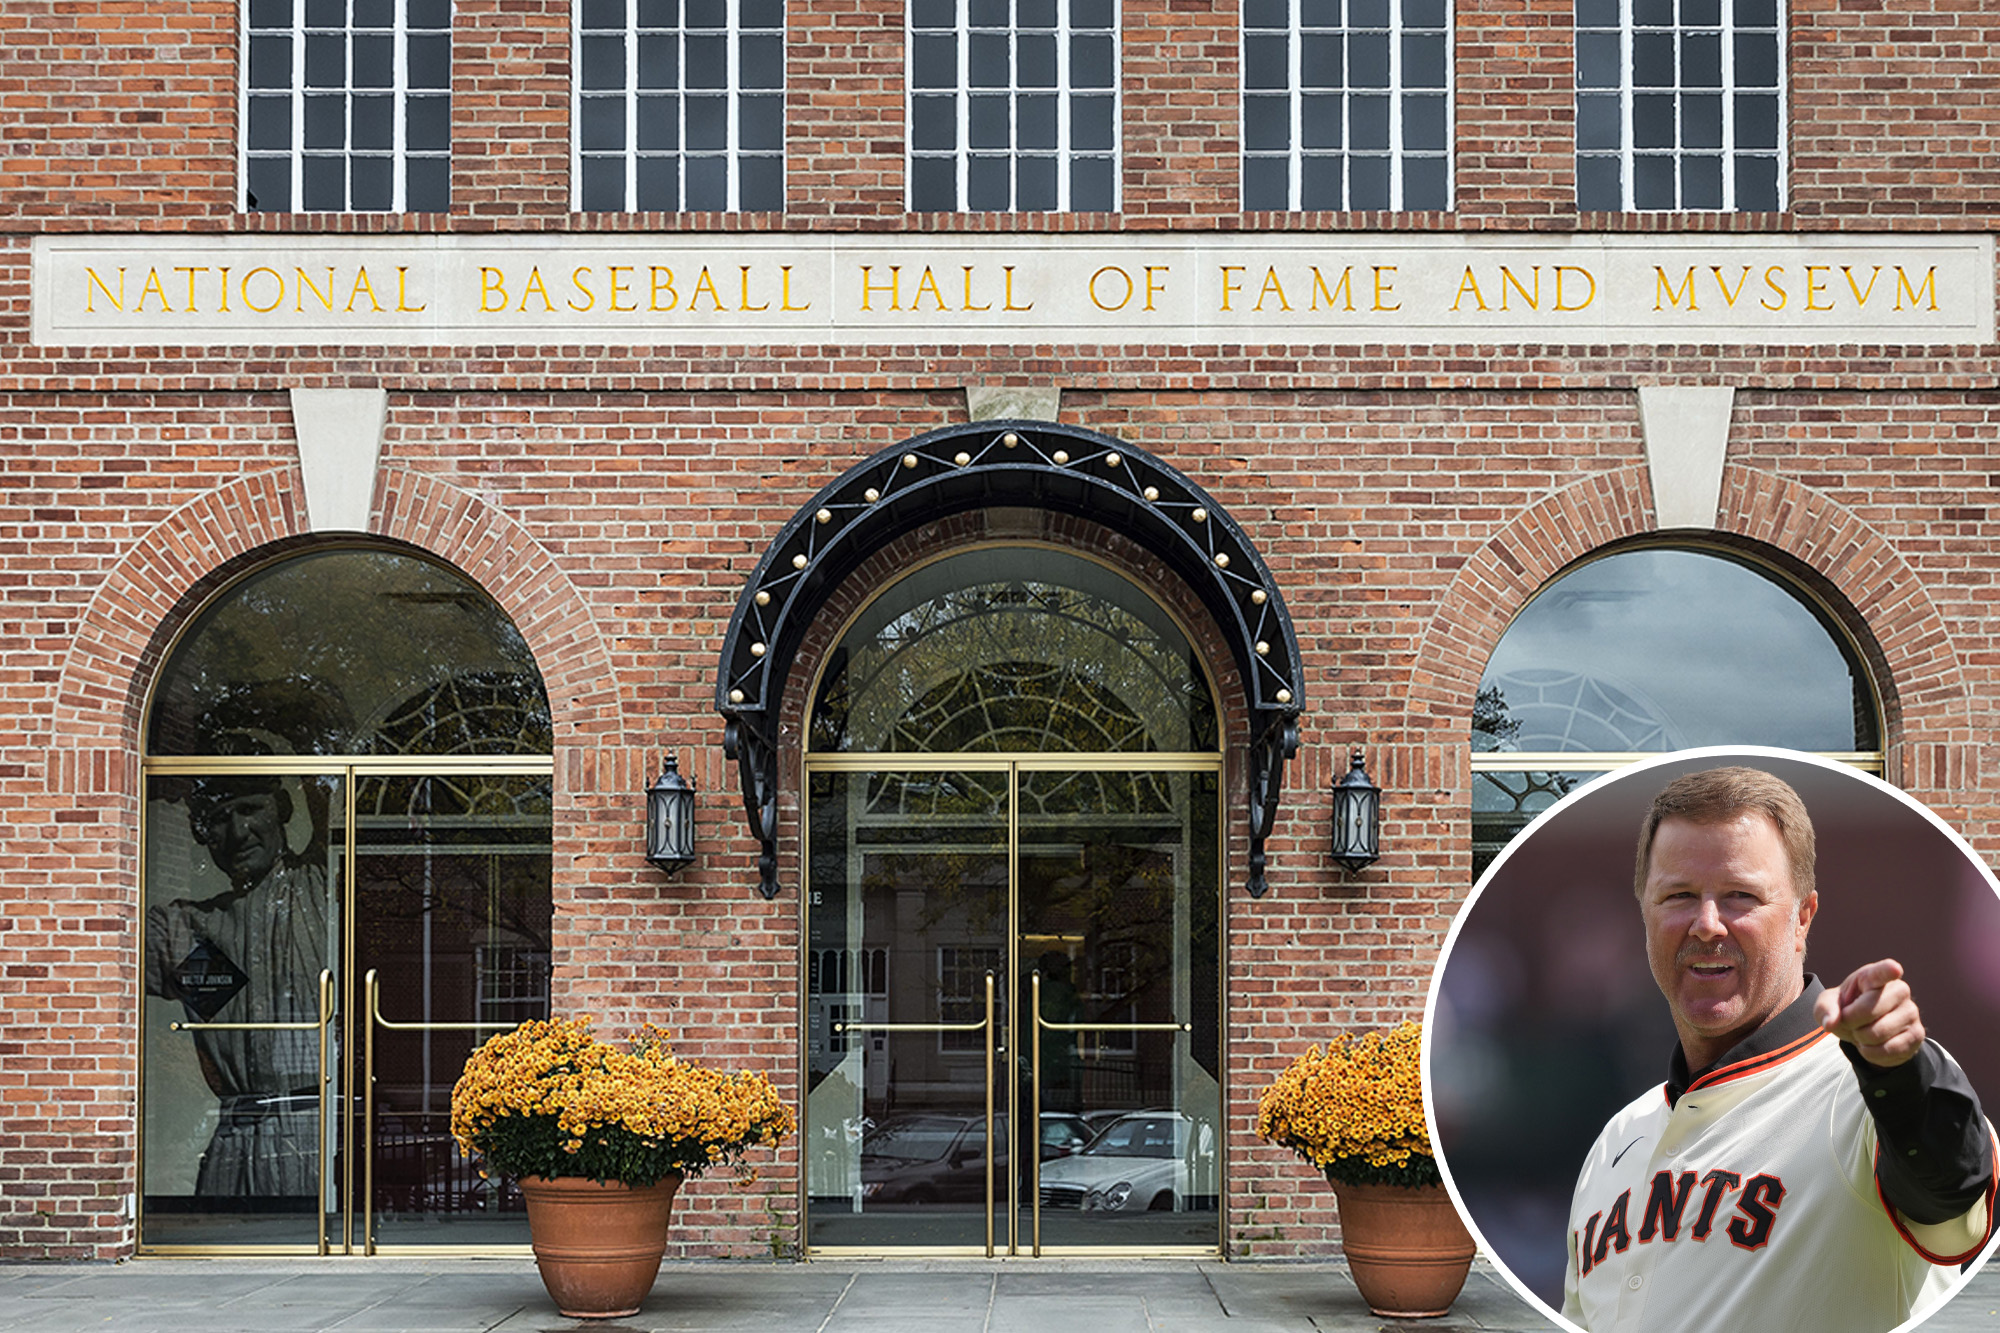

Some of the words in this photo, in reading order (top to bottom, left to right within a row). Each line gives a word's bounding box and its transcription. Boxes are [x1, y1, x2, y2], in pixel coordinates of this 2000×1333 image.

[84, 266, 426, 313] NATIONAL
[477, 266, 811, 312] BASEBALL
[859, 265, 1034, 312] HALL
[1088, 265, 1170, 312] OF
[1219, 265, 1402, 312] FAME
[1449, 265, 1597, 312] AND
[1652, 265, 1941, 312] MVSEVM
[1574, 1168, 1787, 1279] IANTS
